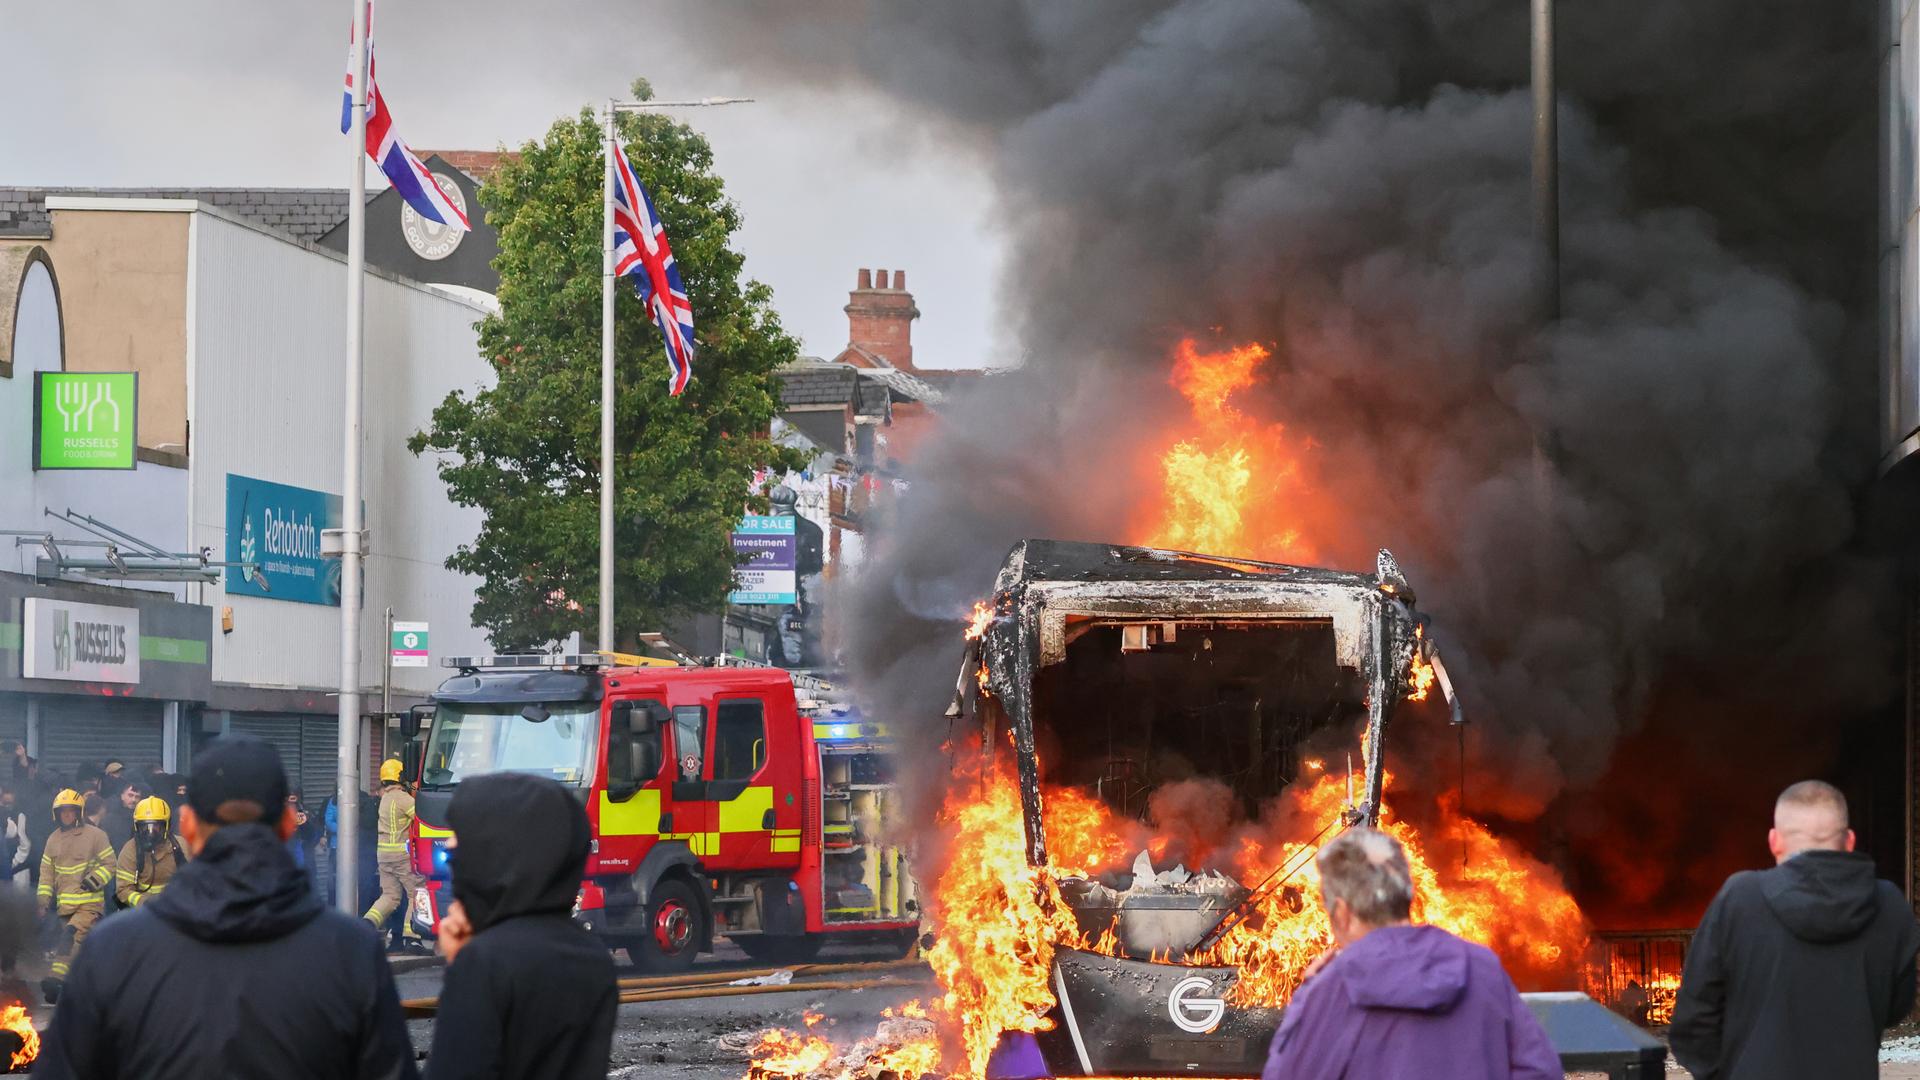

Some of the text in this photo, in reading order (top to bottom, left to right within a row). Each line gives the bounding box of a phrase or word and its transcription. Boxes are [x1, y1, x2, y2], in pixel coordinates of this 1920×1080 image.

[407, 226, 425, 250] GOD
[425, 243, 449, 255] AND
[742, 519, 792, 529] OR SALE
[733, 538, 787, 547] Investment
